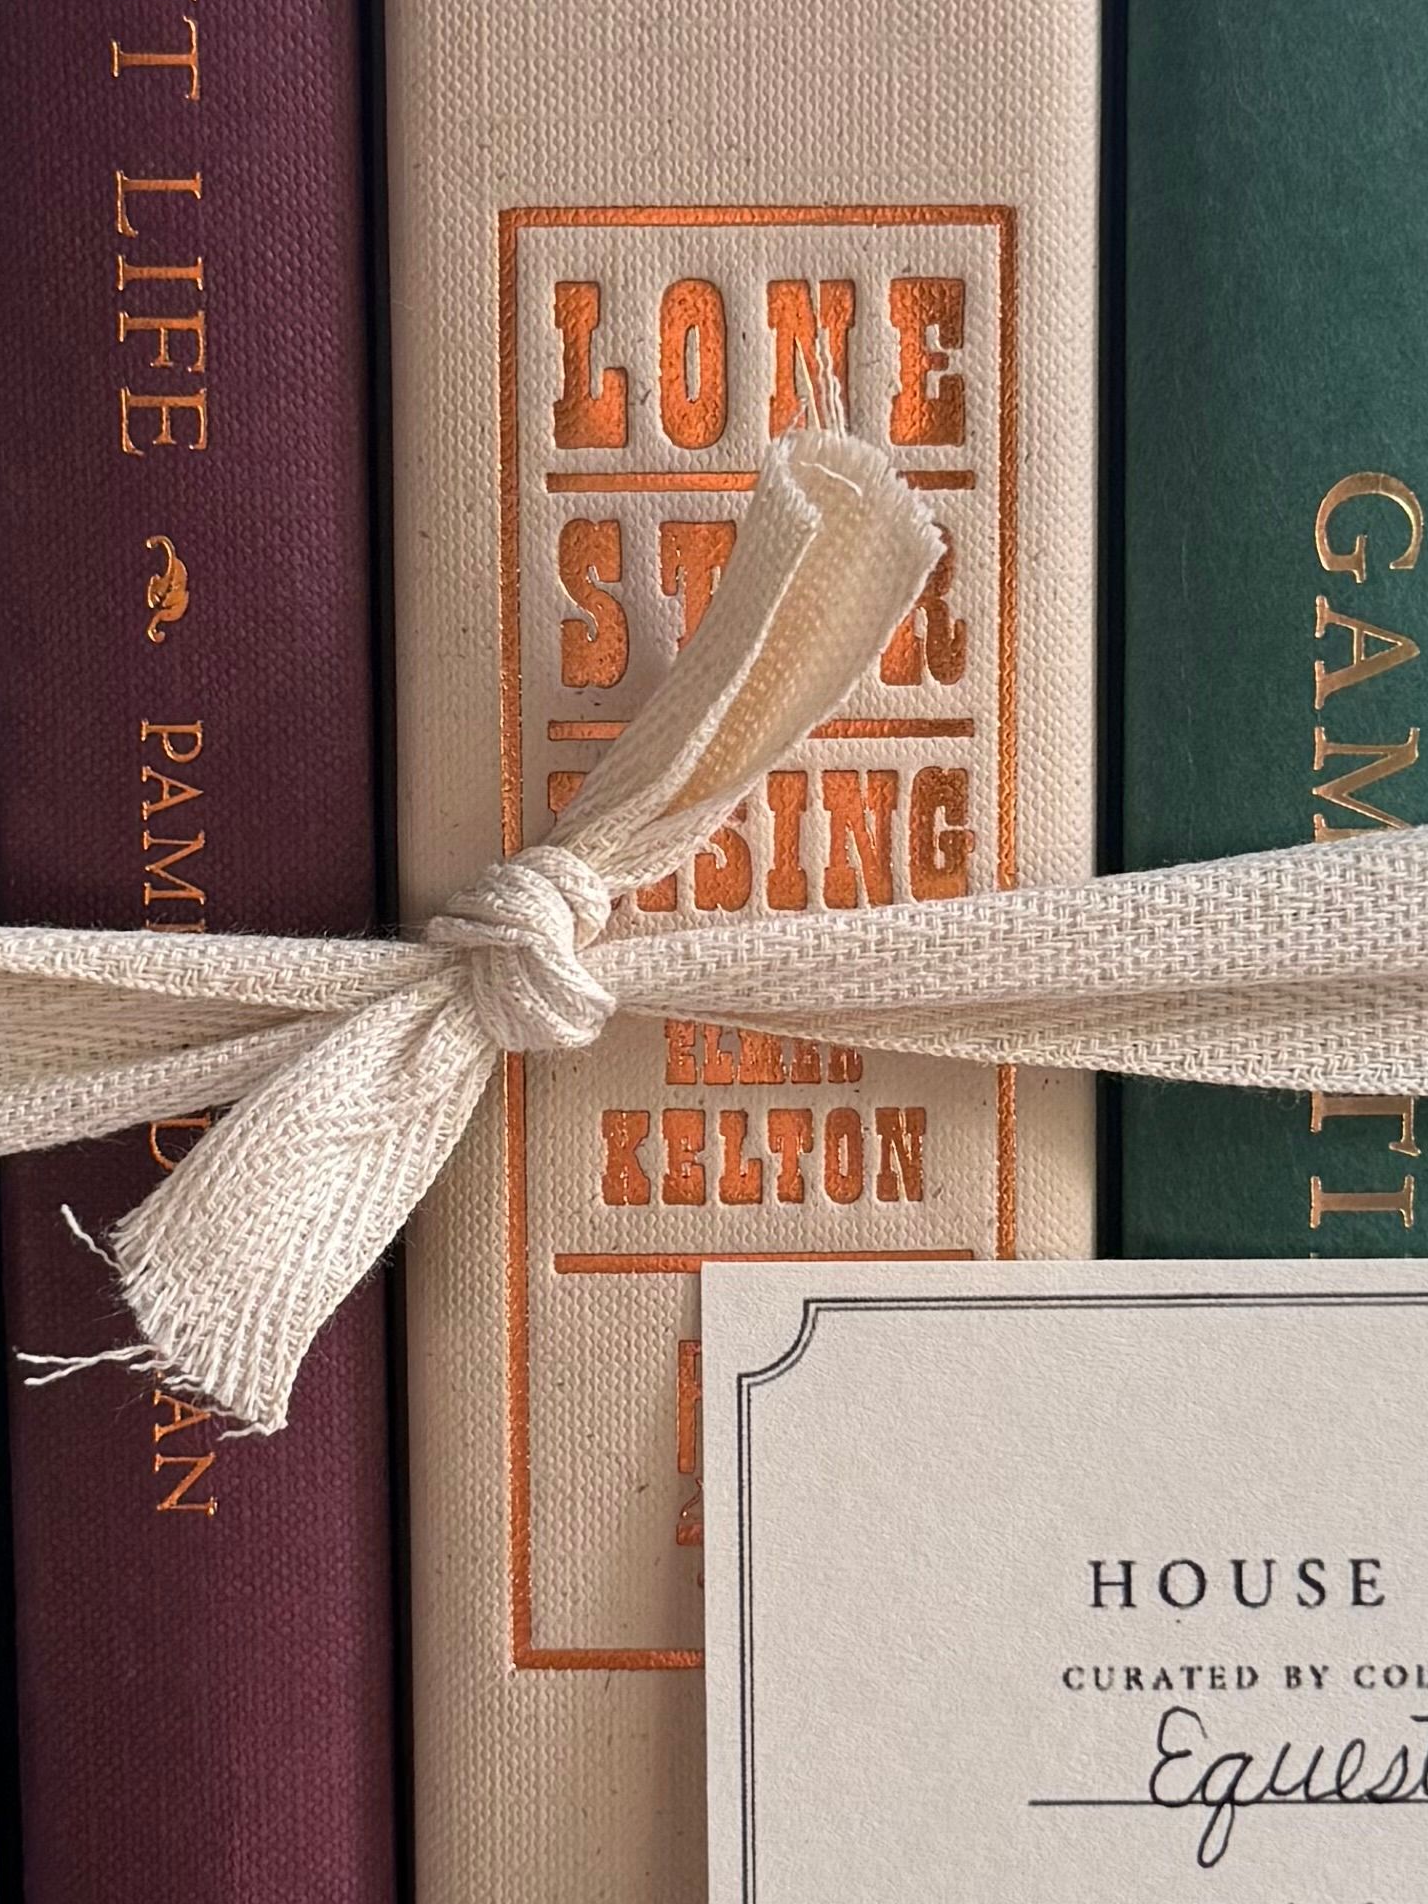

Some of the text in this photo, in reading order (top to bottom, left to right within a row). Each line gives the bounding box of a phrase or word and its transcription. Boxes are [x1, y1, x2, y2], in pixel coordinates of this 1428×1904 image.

[116, 169, 206, 456] LIFE
[553, 277, 965, 449] LONE
[558, 518, 966, 689] STR
[1313, 471, 1425, 843] GAM
[601, 1107, 927, 1206] KELTON
[1088, 1558, 1387, 1611] HOUSE
[1062, 1664, 1261, 1693] CURATED
[1285, 1662, 1331, 1691] BY
